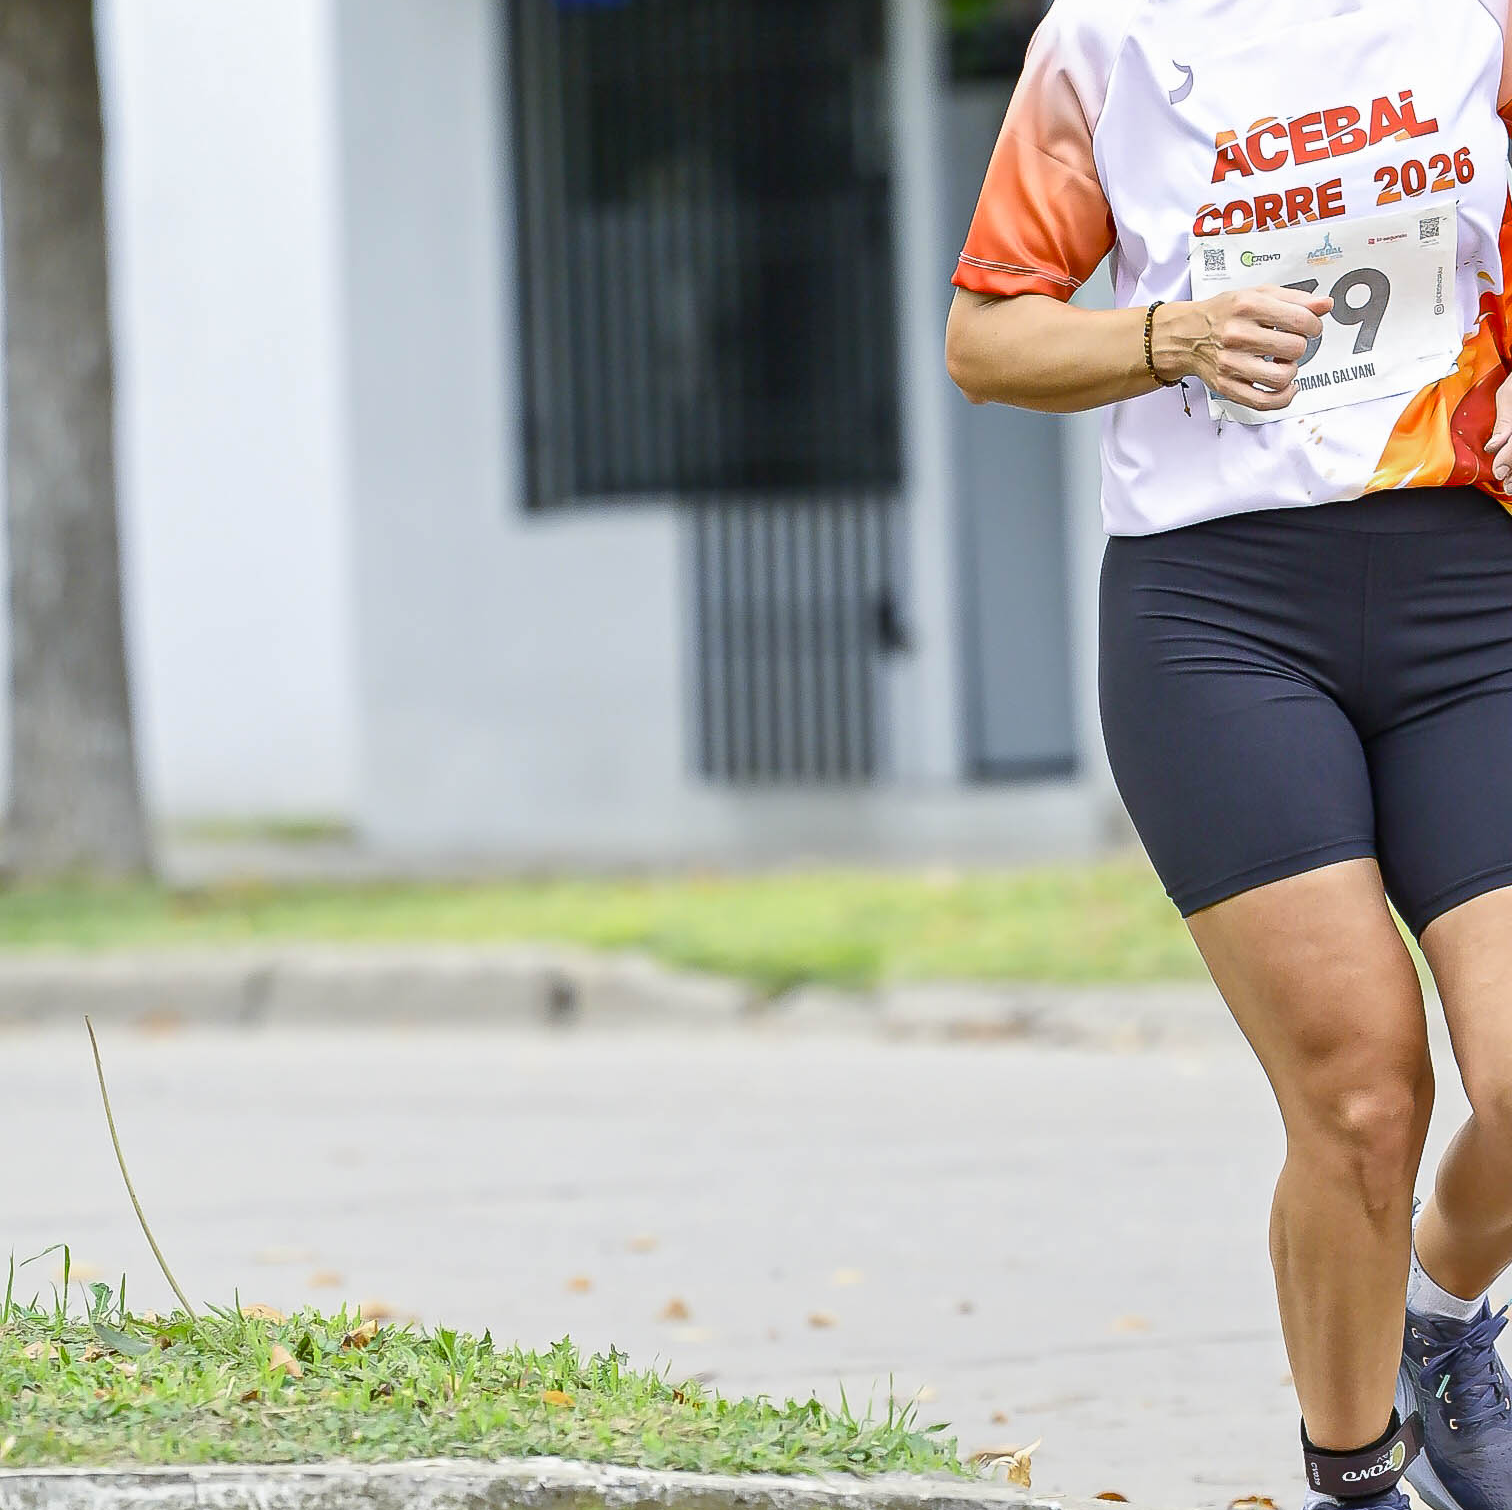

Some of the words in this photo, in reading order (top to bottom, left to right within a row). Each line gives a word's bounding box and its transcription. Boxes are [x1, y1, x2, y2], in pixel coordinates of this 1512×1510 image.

[1211, 90, 1439, 184] ACEBAL
[1193, 178, 1346, 237] CORRE
[1374, 146, 1475, 206] 2026
[1293, 372, 1332, 391] DRIANA
[1332, 363, 1376, 384] GALVANI
